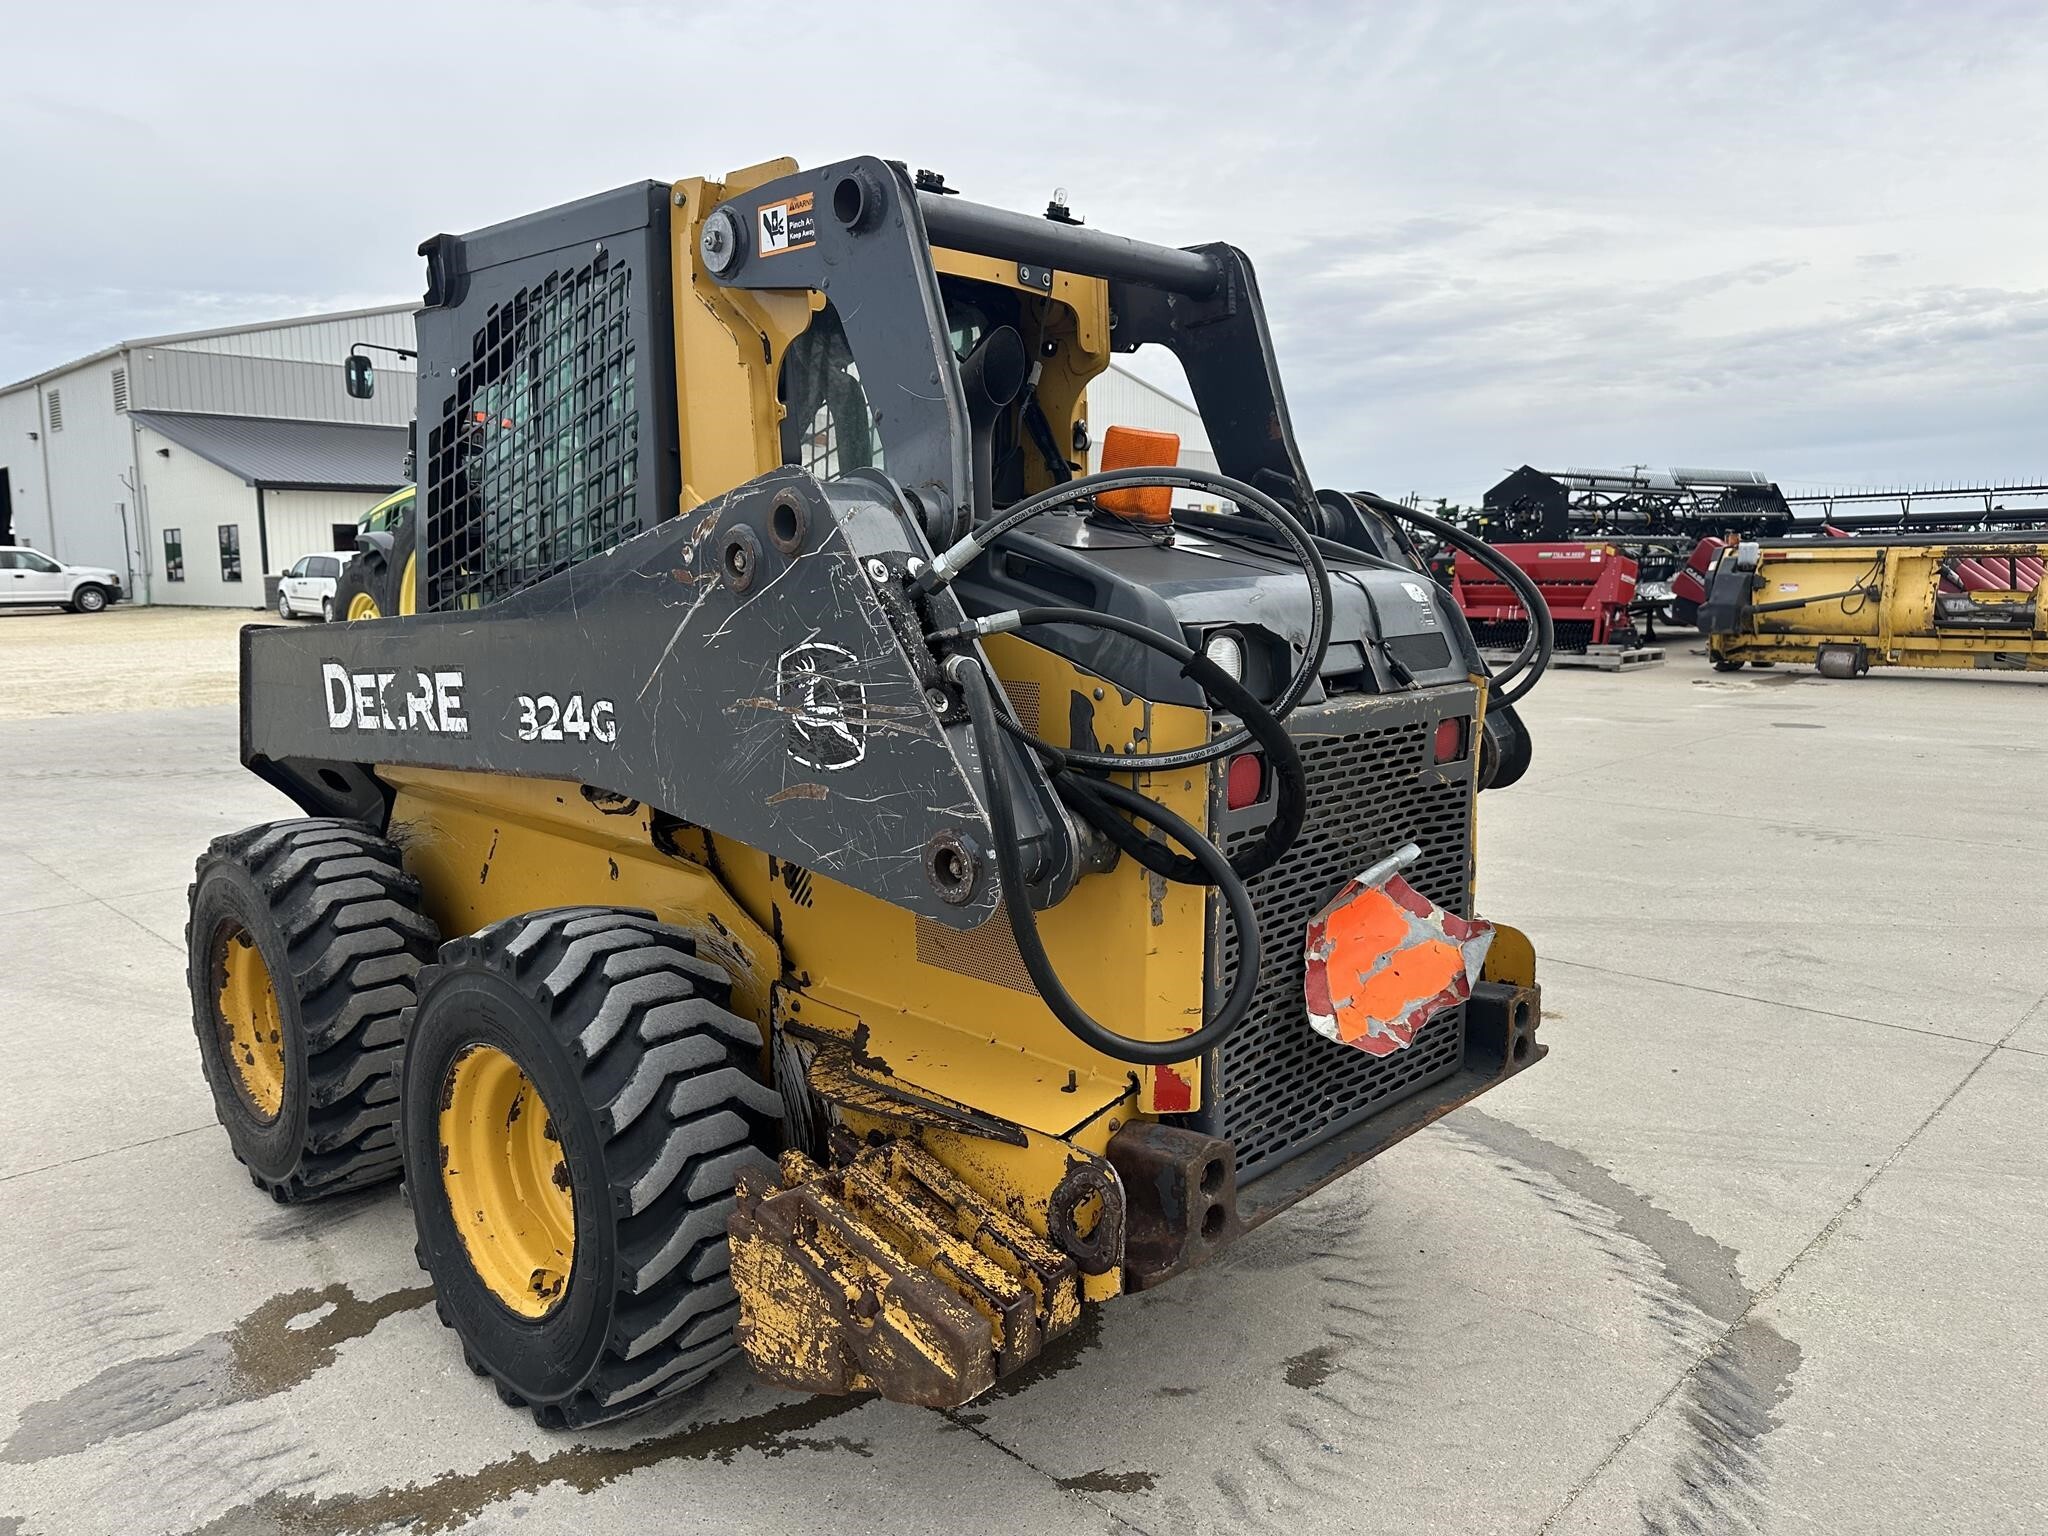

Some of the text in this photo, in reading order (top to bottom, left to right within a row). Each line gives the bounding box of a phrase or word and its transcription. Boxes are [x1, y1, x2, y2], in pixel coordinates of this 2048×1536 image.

[789, 219, 805, 230] Pinch
[789, 232, 801, 240] Keep
[517, 695, 617, 743] 324G
